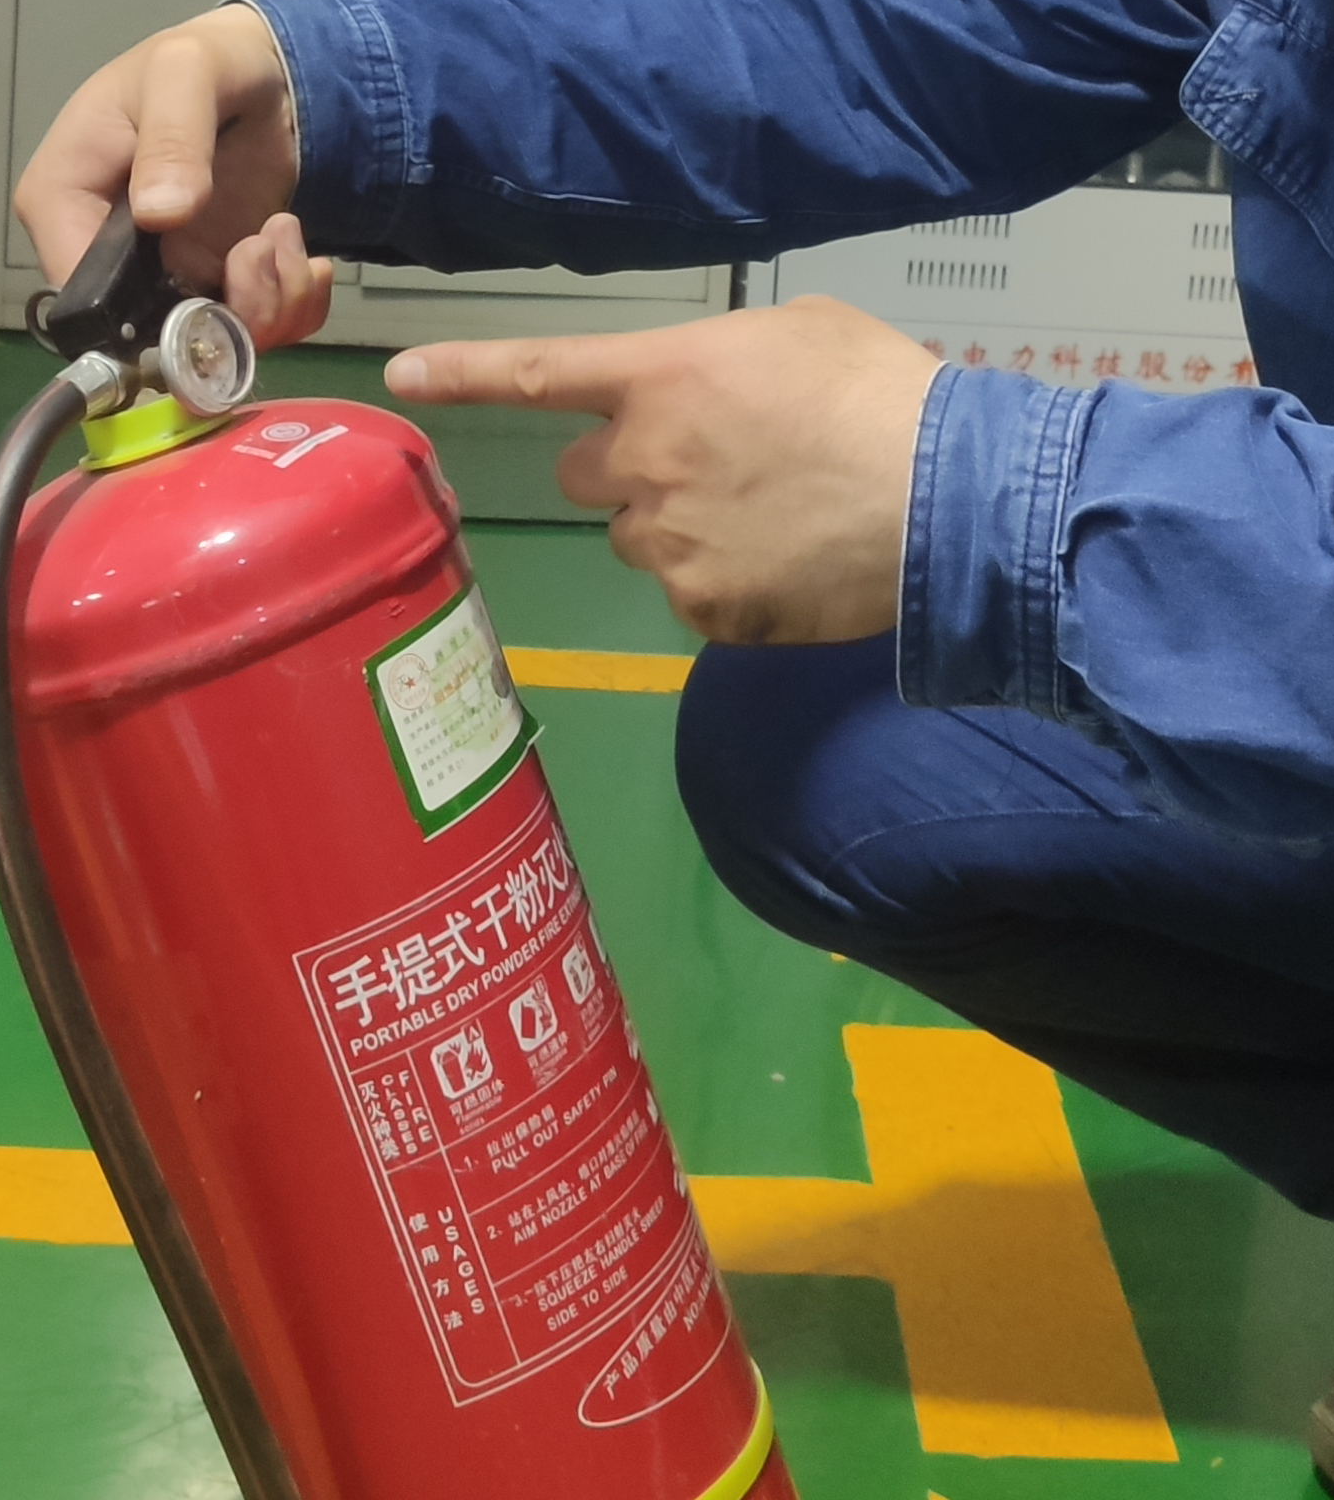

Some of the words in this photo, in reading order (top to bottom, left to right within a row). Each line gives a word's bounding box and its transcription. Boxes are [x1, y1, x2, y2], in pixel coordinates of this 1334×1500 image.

[350, 999, 446, 1057] PORTABLE
[446, 978, 480, 1012] DRY
[482, 939, 541, 990] POWDER
[538, 914, 563, 949] FIRE
[358, 1080, 400, 1161] 灭火种类
[449, 1078, 505, 1120] 可燃固体
[492, 1145, 530, 1174] PULL
[533, 1120, 560, 1148] OUT
[563, 1086, 602, 1126] SAFETY
[513, 1221, 538, 1245] AIM
[541, 1187, 588, 1228] NOZZLE
[589, 1172, 602, 1194] AT
[409, 1213, 464, 1330] 使用方法
[438, 1206, 485, 1314] USAGES
[538, 1265, 598, 1312] SQUEEZE
[600, 1231, 640, 1270] HANDLE
[547, 1303, 579, 1331] SIDE
[581, 1289, 599, 1308] TO
[602, 1265, 628, 1294] SIDE
